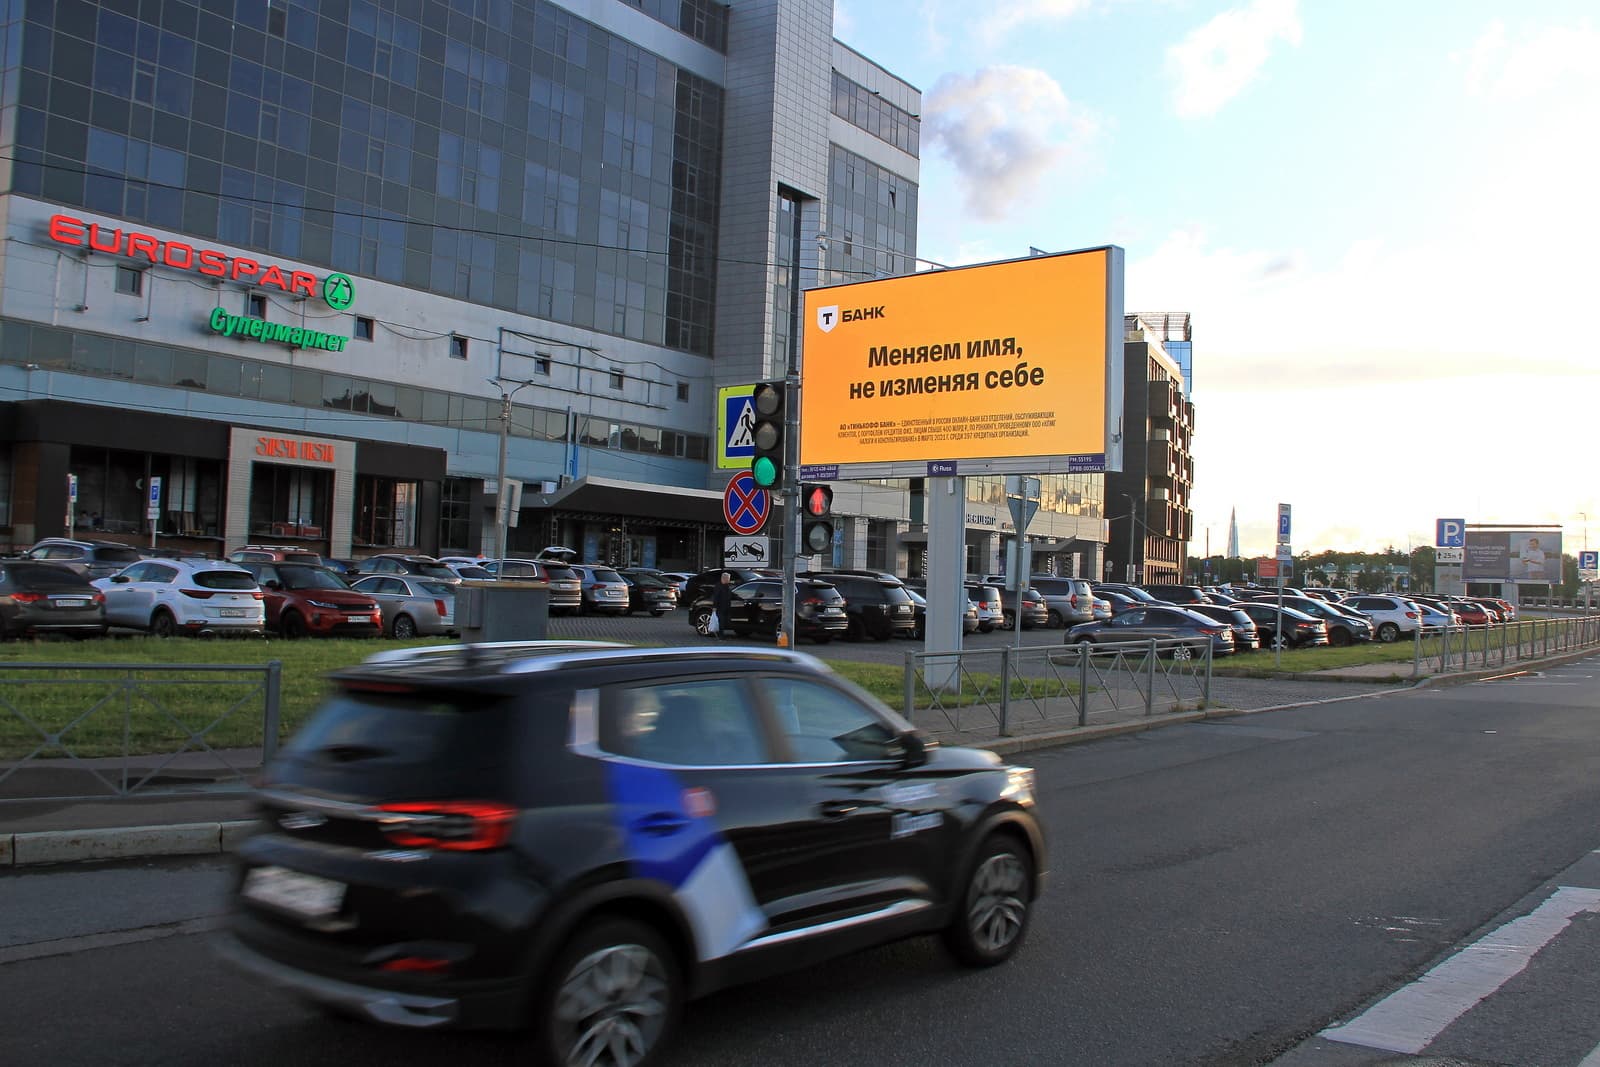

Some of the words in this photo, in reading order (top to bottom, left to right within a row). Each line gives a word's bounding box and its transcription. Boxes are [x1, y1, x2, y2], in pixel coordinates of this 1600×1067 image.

[49, 214, 318, 297] EUROSPAR
[209, 307, 349, 352] Супермаркет
[842, 305, 886, 322] БАНК
[868, 342, 961, 368] Меняем
[967, 337, 1023, 358] имя,
[849, 382, 875, 400] не
[880, 370, 980, 397] изменяя
[984, 362, 1045, 388] себе
[1444, 521, 1460, 544] P
